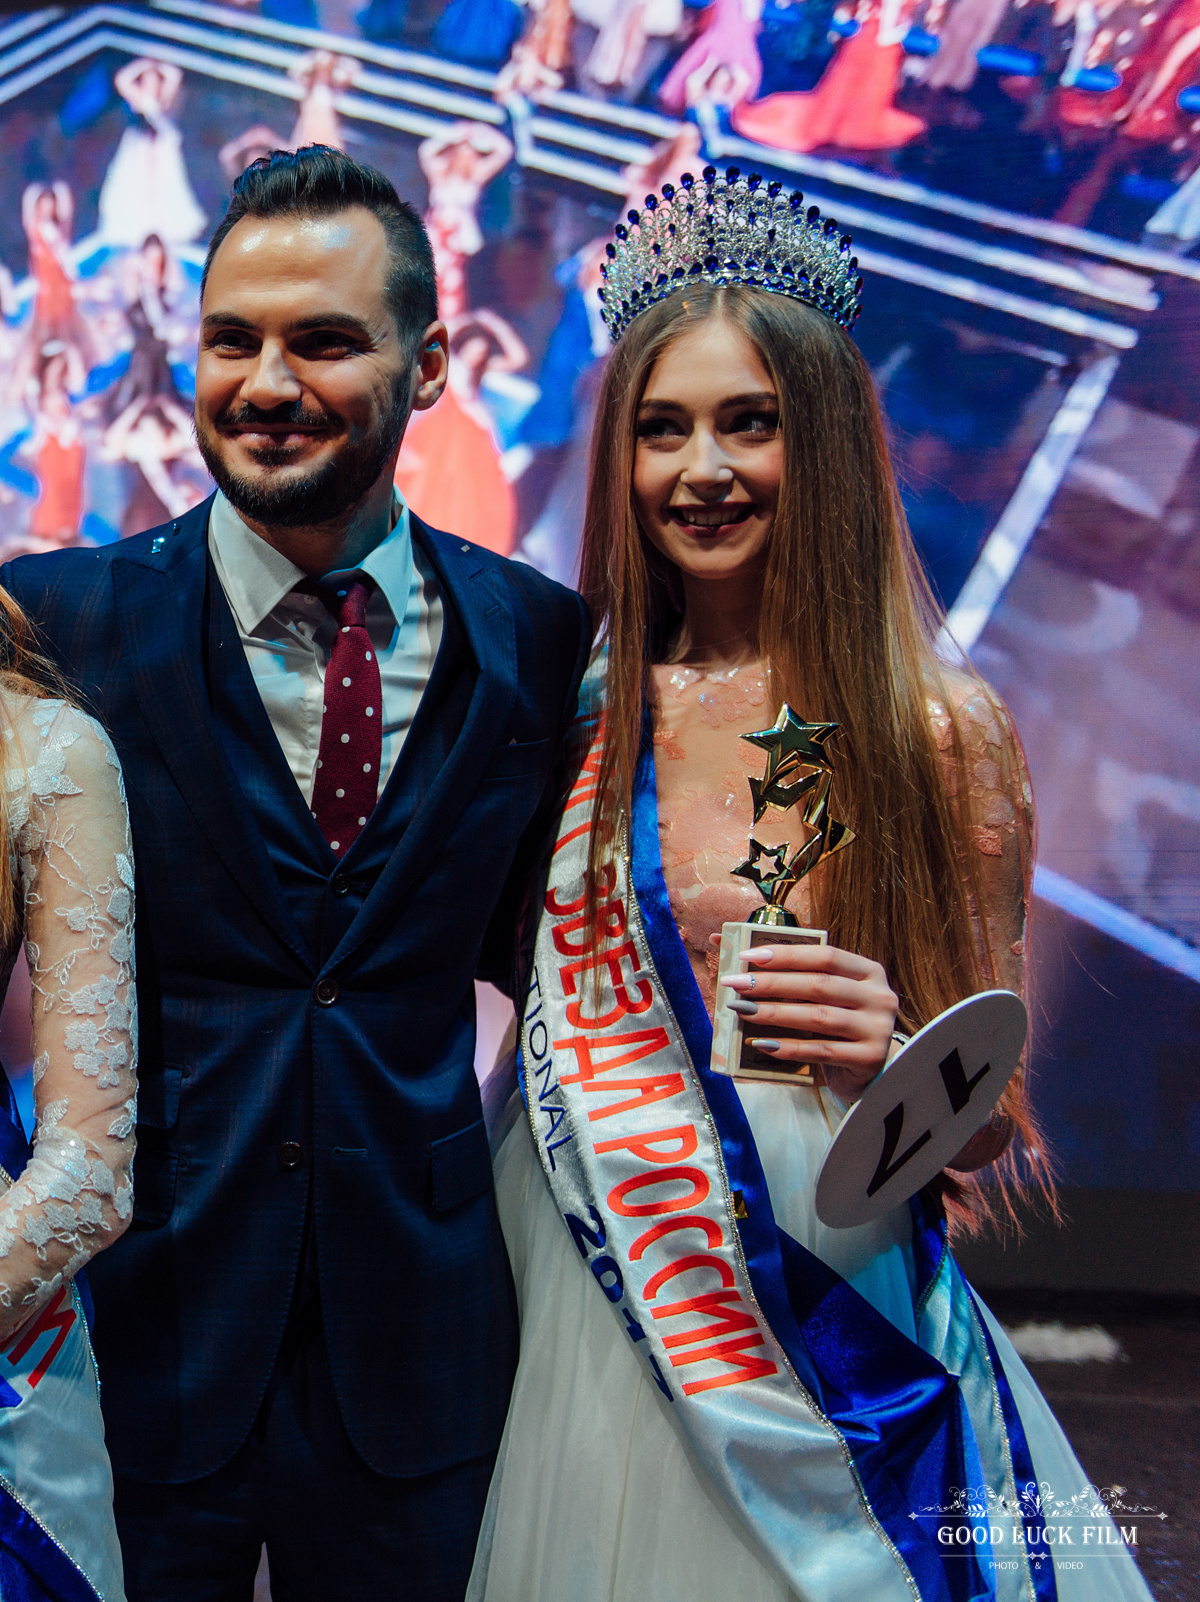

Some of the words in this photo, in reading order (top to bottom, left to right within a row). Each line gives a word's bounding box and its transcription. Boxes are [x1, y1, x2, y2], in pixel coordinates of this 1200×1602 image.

[545, 862, 687, 1123] ЗВЕЗДА
[866, 1047, 991, 1199] 17
[593, 1124, 779, 1397] РОССИИ
